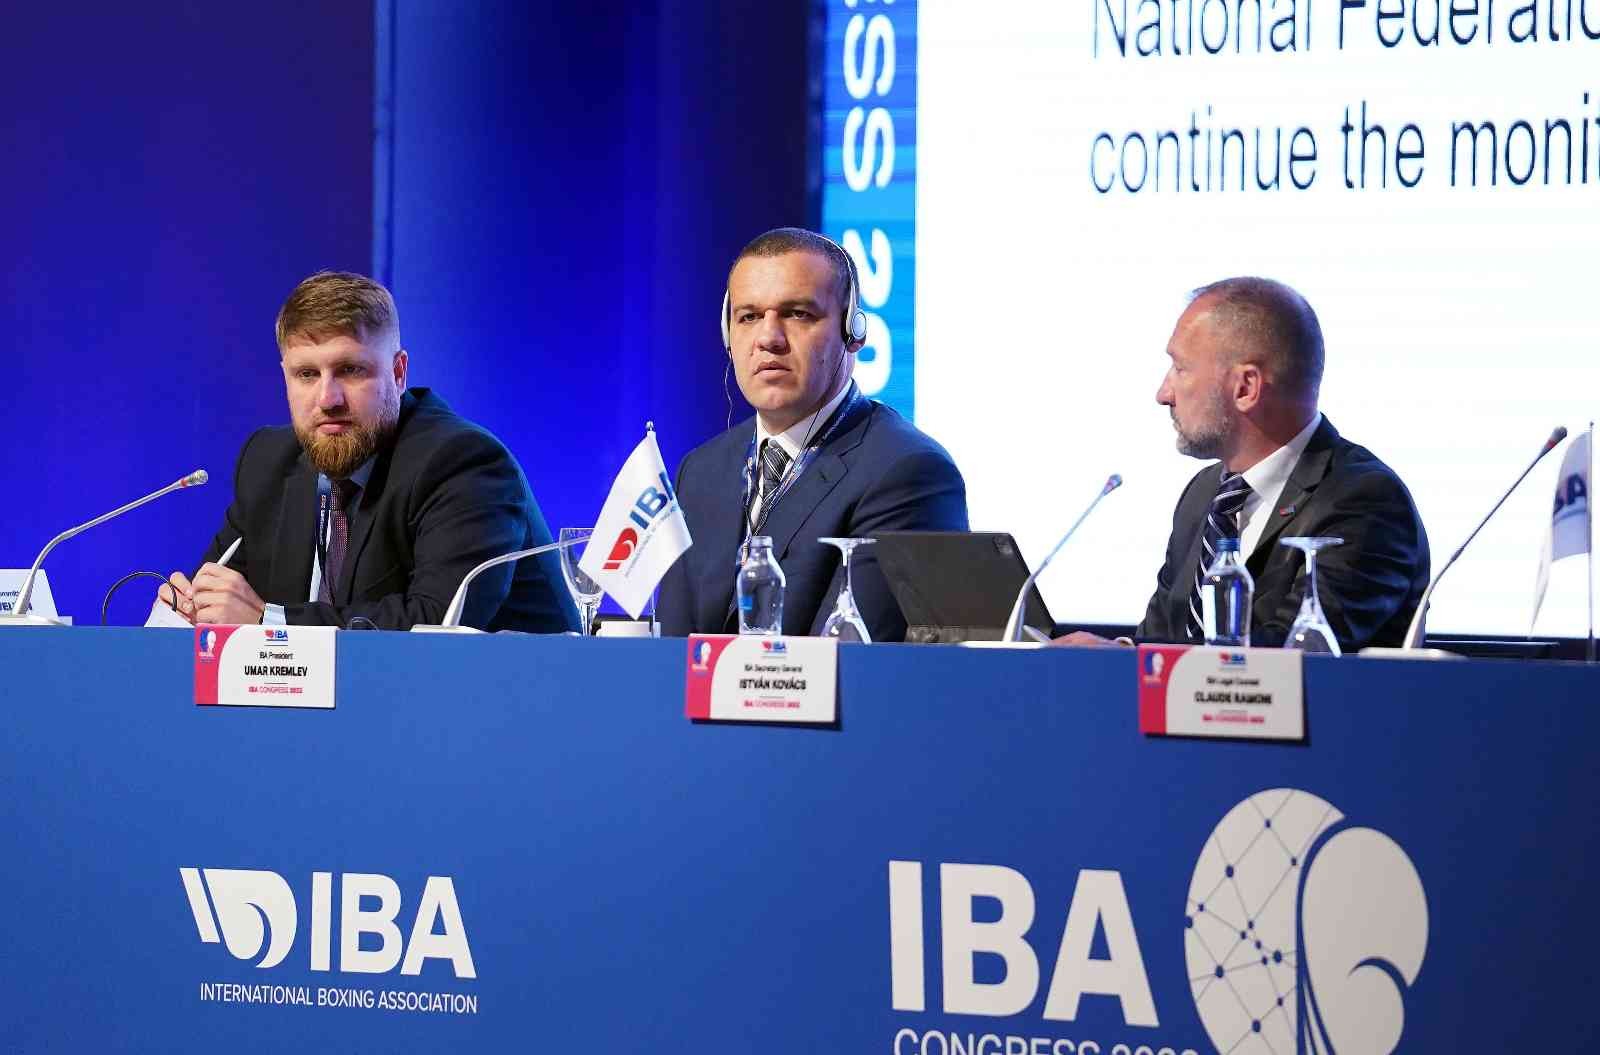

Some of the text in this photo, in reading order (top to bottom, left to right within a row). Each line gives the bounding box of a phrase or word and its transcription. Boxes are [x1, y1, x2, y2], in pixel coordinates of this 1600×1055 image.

[1094, 0, 1311, 58] National
[843, 0, 896, 192] SS
[1090, 92, 1600, 194] continue the moni
[244, 665, 308, 677] UMAR KREMLEV
[739, 676, 806, 690] ISTVÁN KOVÁCS
[310, 871, 477, 979] IBA
[888, 859, 1160, 1028] IBA
[200, 983, 477, 1014] INTERNATIONAL BOXING ASSOCIATION
